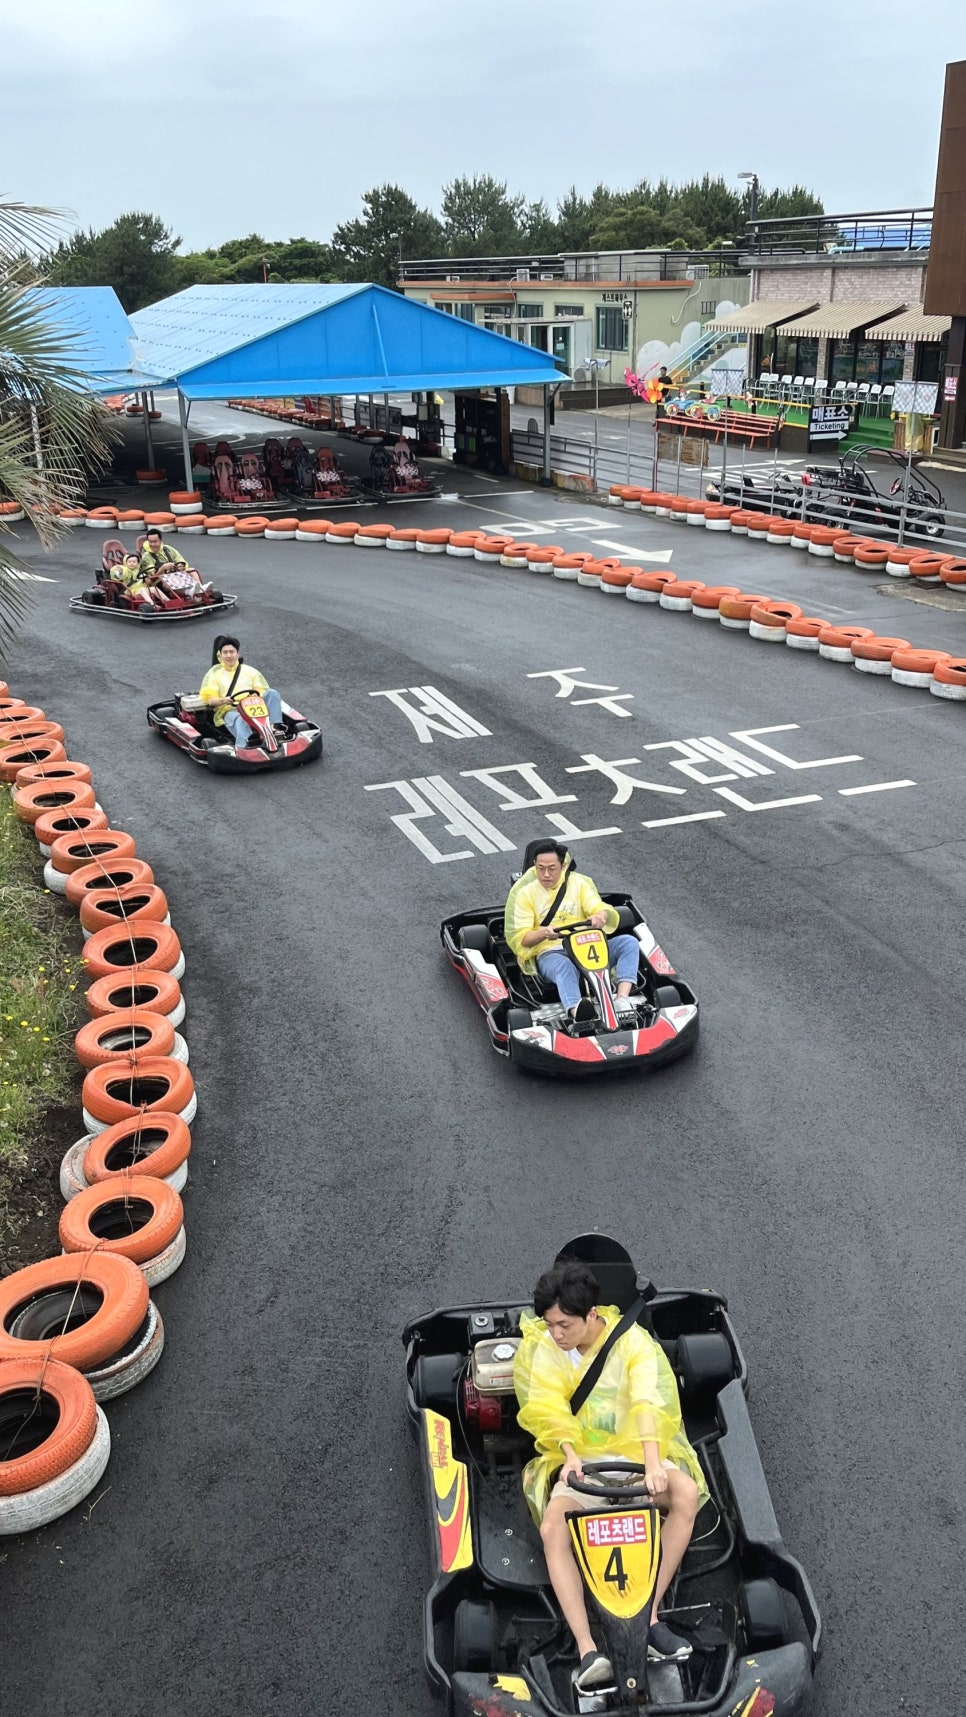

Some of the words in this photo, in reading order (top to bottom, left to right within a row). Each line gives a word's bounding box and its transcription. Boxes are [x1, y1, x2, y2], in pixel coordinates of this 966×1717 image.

[812, 405, 849, 421] 매표소
[814, 422, 846, 431] Ticketing
[250, 707, 265, 716] 23
[363, 723, 917, 864] 레포츠랜드
[588, 945, 600, 963] 4
[587, 1516, 647, 1546] 레포츠랜드
[603, 1546, 629, 1591] 4
